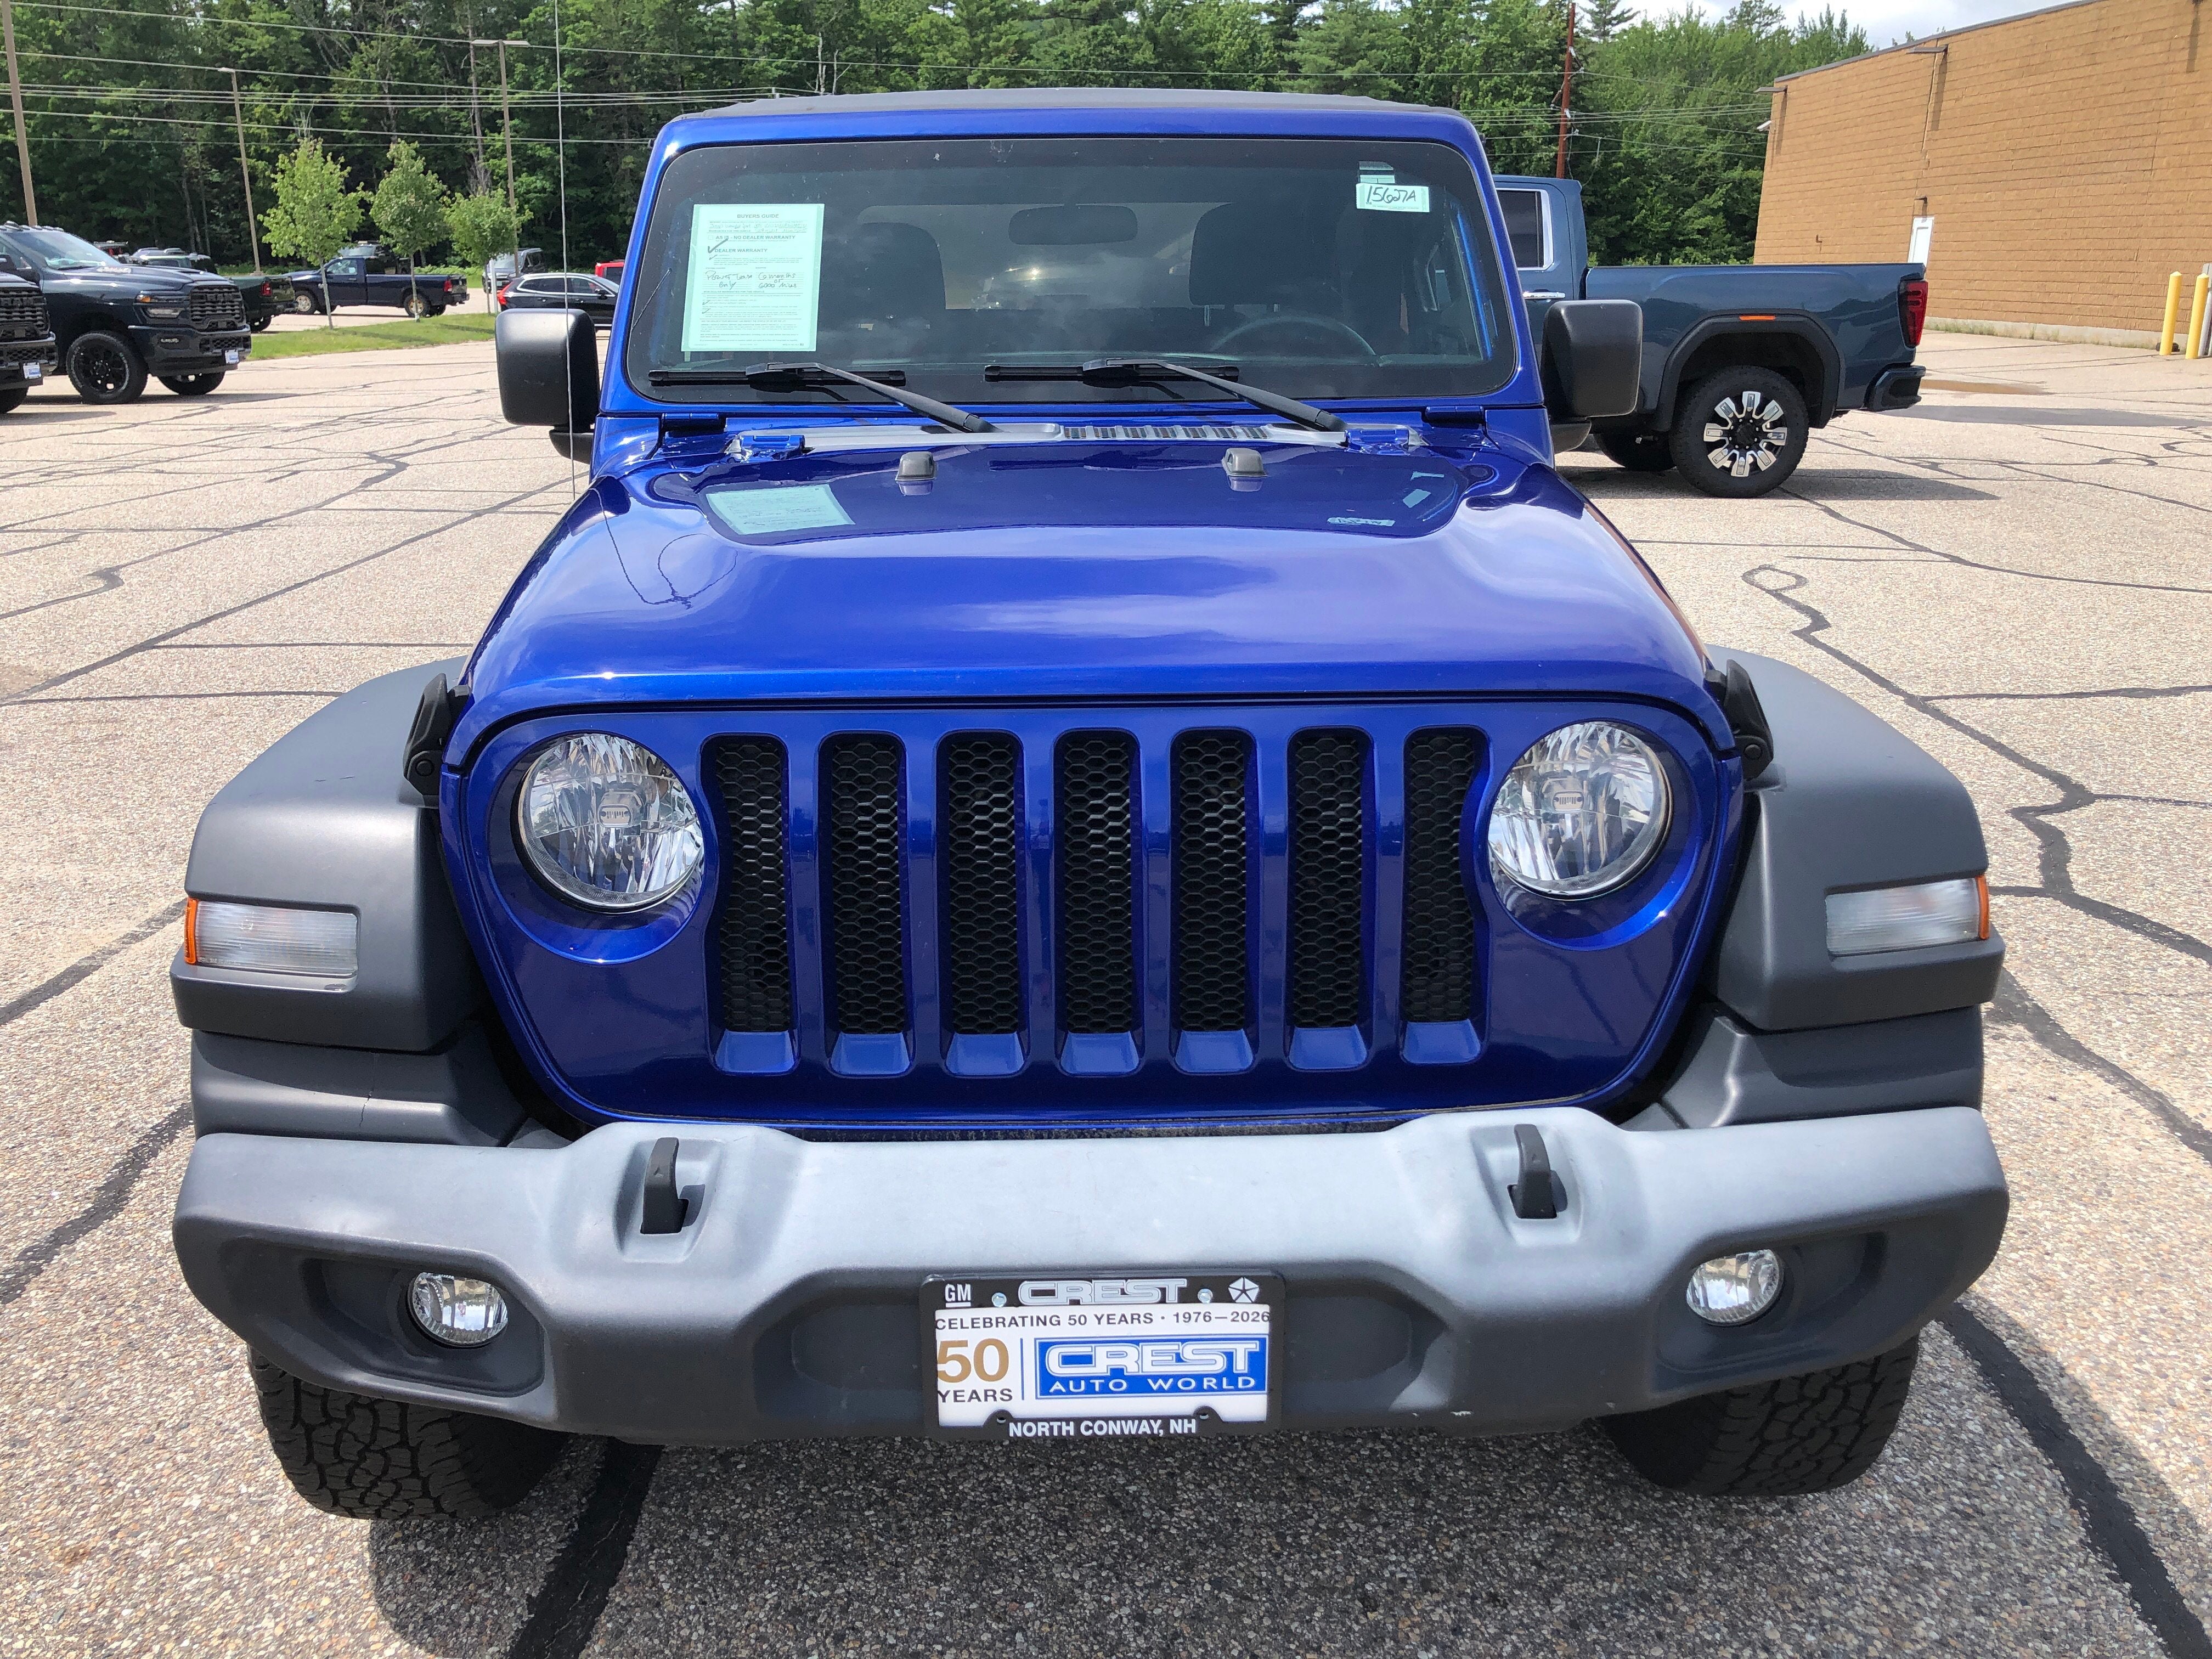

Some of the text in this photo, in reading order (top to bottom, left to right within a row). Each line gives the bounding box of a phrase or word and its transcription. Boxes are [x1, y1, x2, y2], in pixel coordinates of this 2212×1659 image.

[1367, 185, 1416, 204] 15627A
[945, 1284, 972, 1301] GM
[1018, 1278, 1187, 1306] CREST
[935, 1315, 1061, 1330] CELEBRATING
[1068, 1313, 1087, 1326] 50
[1093, 1312, 1154, 1325] YEARS
[937, 1338, 1009, 1383] 50
[1045, 1340, 1260, 1377] CREST
[1049, 1376, 1255, 1392] AUTO WORLD
[938, 1389, 1013, 1403] YEARS
[1009, 1419, 1196, 1437] NORTH CONWAY, NH
